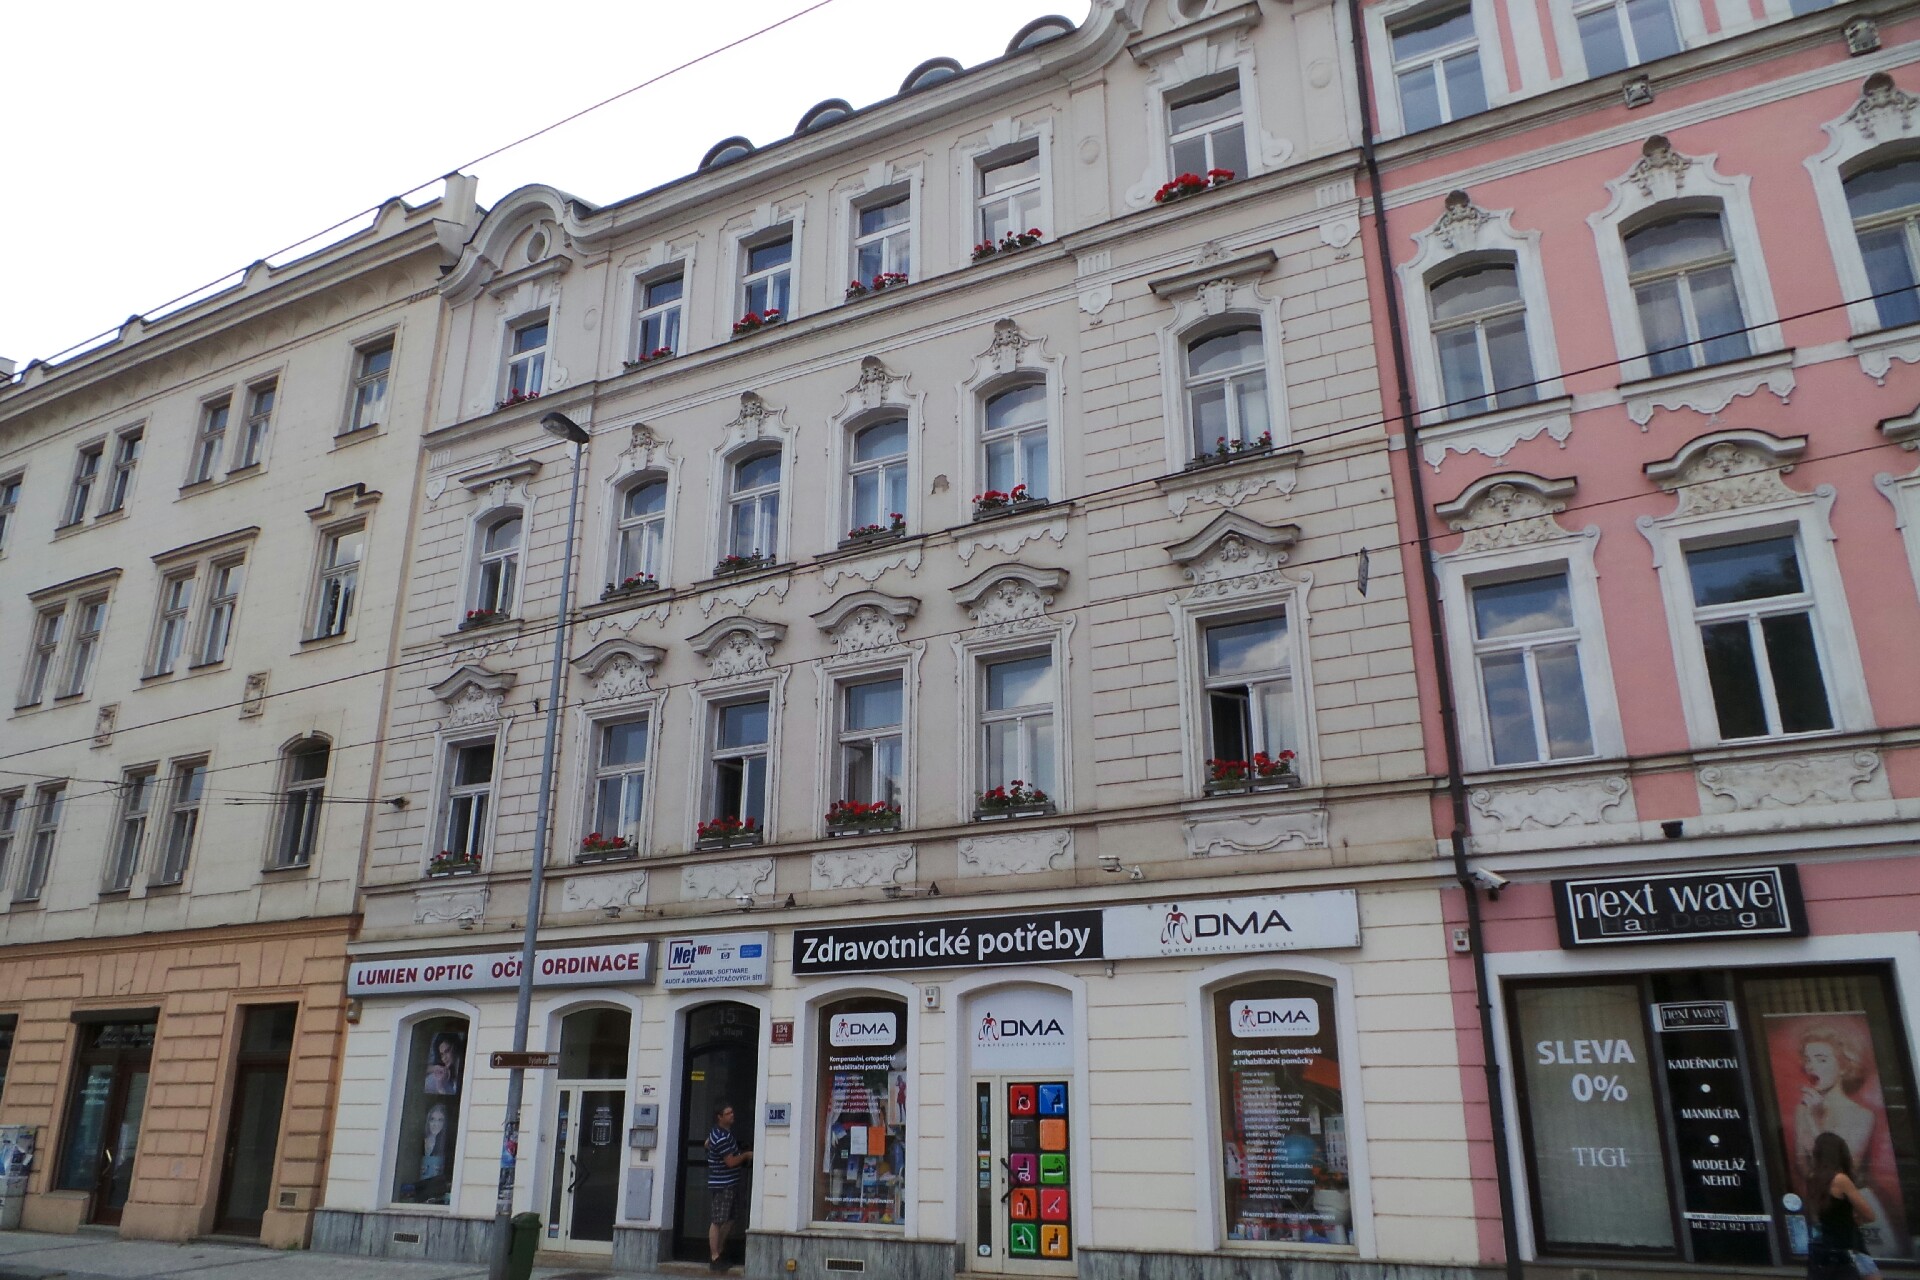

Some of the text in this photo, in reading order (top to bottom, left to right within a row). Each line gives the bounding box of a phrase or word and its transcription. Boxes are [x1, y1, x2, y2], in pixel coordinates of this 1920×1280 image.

[1575, 879, 1773, 918] next wave
[1195, 909, 1293, 938] DMA
[801, 920, 1091, 964] Zdravotnické potřeby
[673, 946, 697, 964] Net
[697, 945, 712, 955] Win
[357, 953, 640, 985] LUMIEN OPTIC OČ ORDINACE
[683, 968, 713, 976] HARDWARE
[718, 967, 749, 975] SOFTWARE
[1257, 1010, 1310, 1024] DMA
[1662, 1008, 1724, 1020] next wave
[776, 1024, 788, 1033] 134
[850, 1022, 890, 1035] DMA
[1001, 1019, 1065, 1036] DMA
[1537, 1039, 1636, 1065] SLEVA
[1668, 1056, 1739, 1070] KADEŘNICTVÍ
[1571, 1073, 1629, 1102] 0%
[1572, 1147, 1627, 1168] TIGI
[1691, 1158, 1747, 1171] MODELÁŽ
[1702, 1174, 1741, 1186] NEHTŮ
